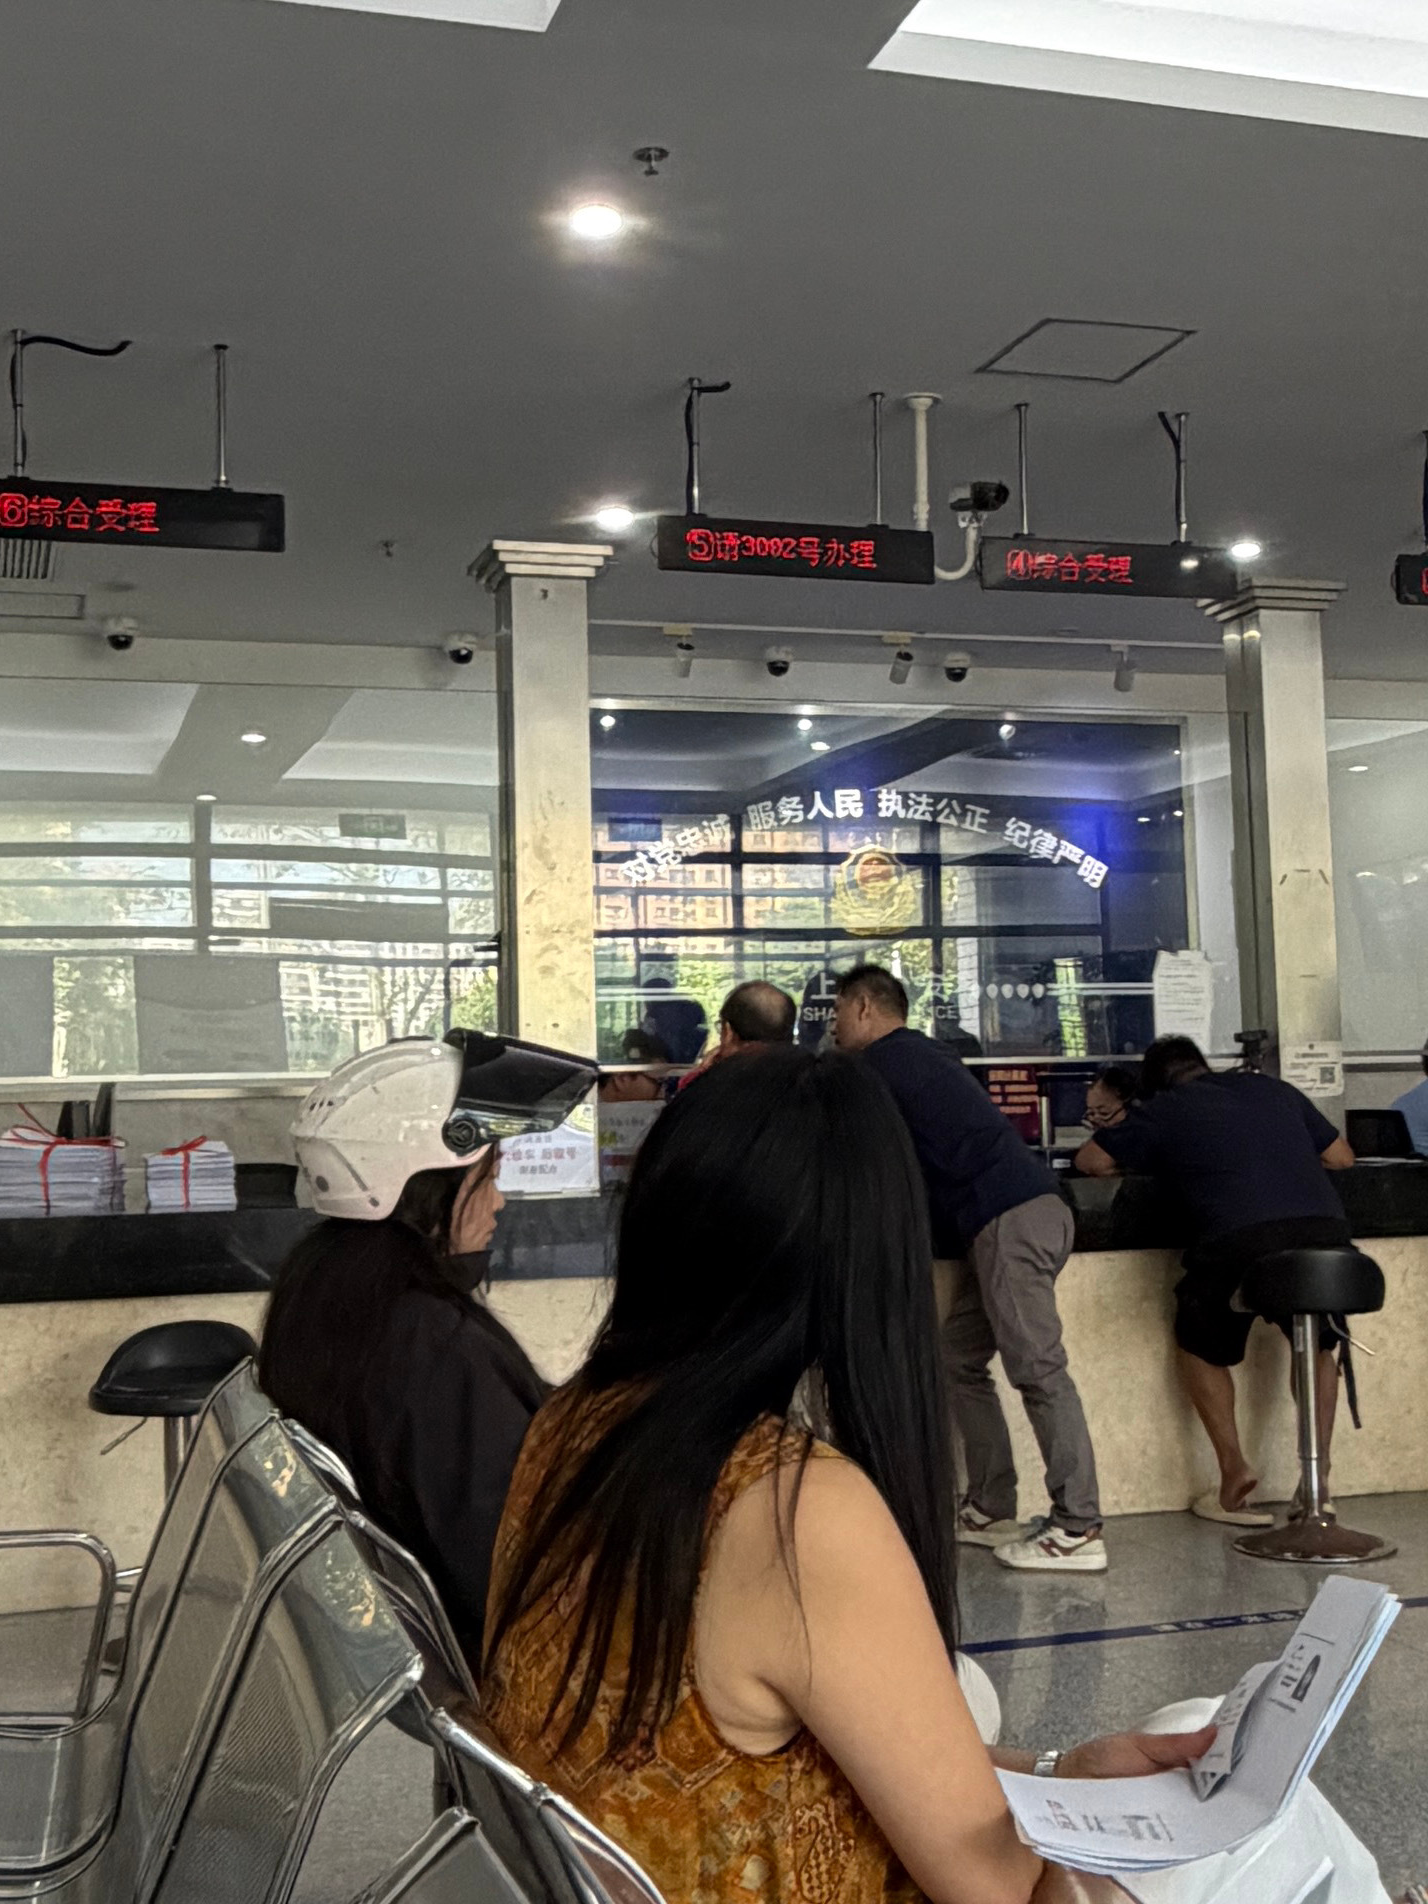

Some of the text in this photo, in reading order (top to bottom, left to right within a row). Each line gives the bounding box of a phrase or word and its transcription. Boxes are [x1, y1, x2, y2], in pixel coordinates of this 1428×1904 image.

[620, 788, 1109, 889] 对党忠诚 服务人民 执法公正 纪律严明
